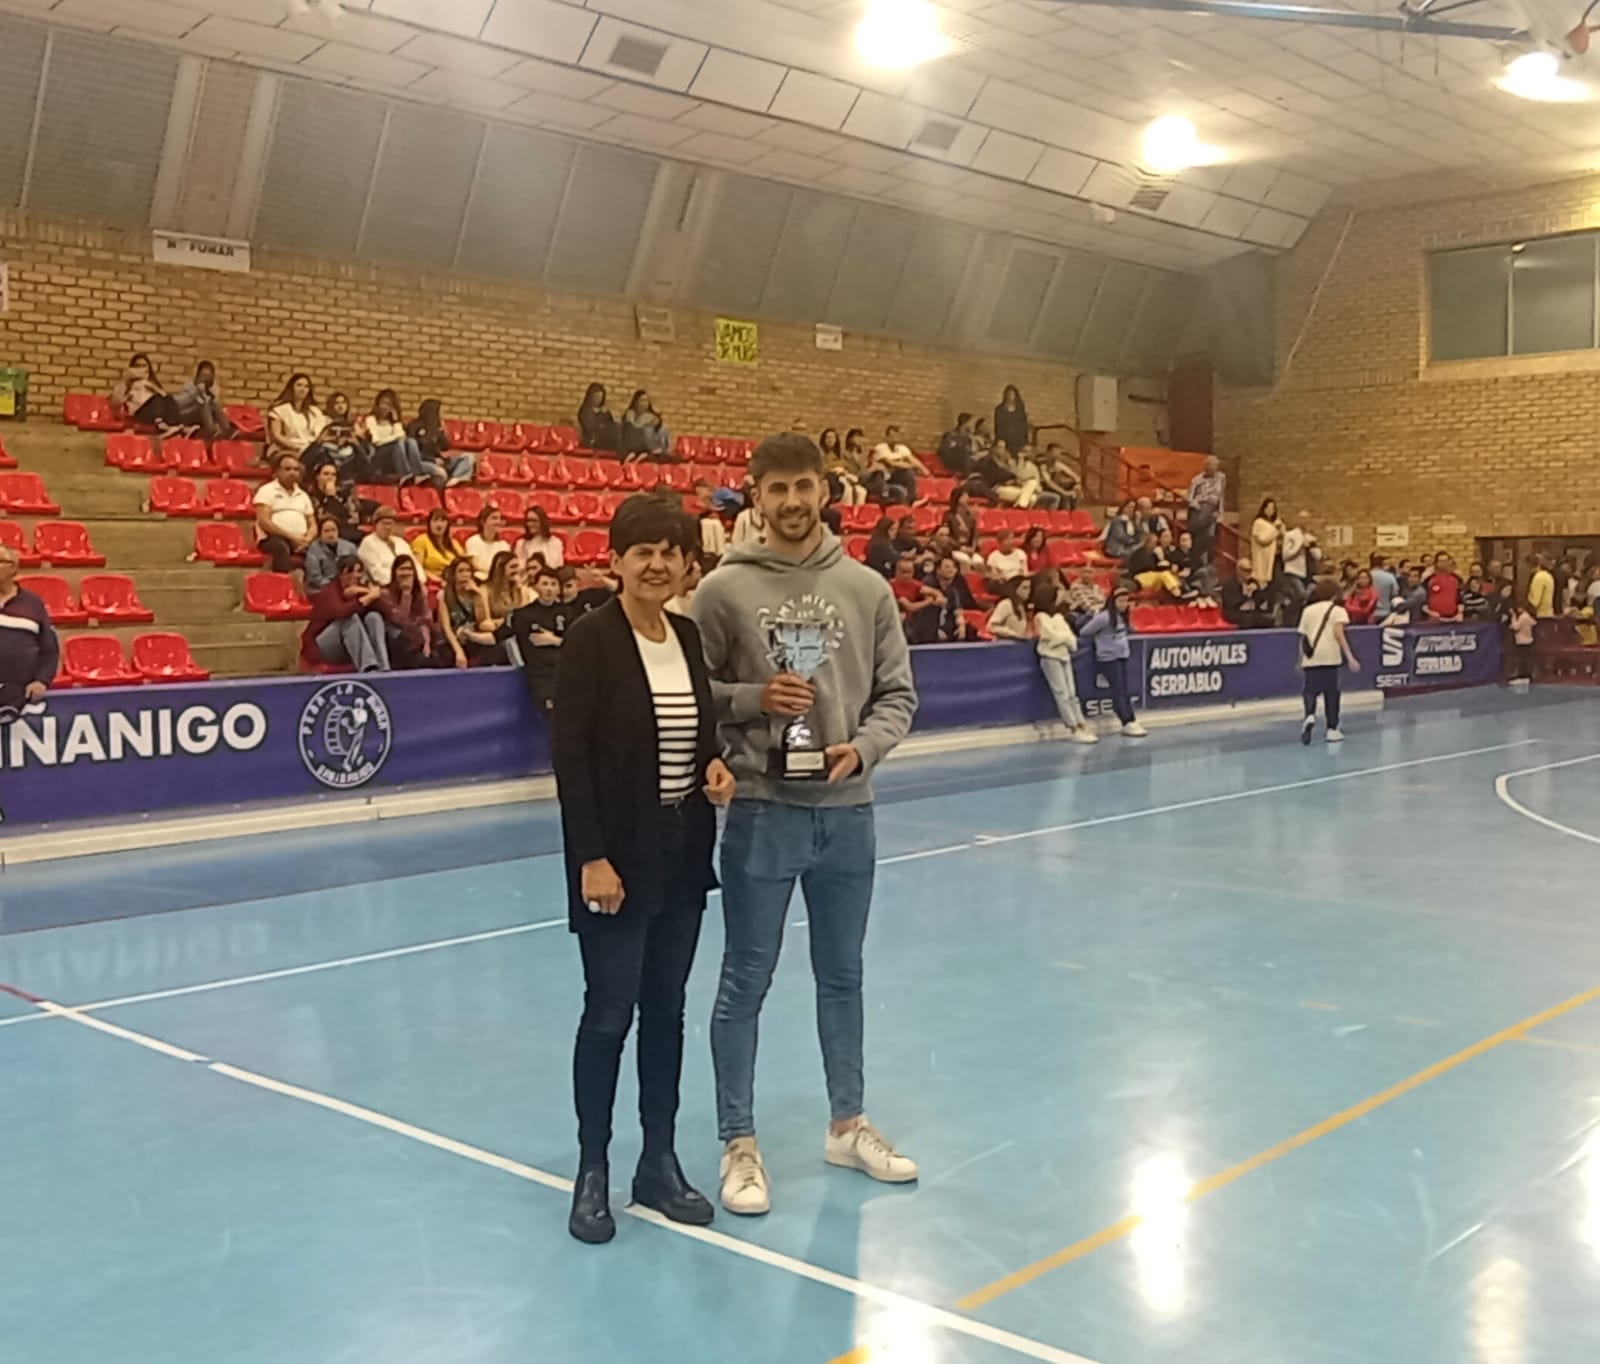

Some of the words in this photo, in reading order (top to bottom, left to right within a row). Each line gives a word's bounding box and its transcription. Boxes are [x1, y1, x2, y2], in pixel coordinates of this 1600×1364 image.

[1150, 640, 1248, 669] AUTOMÓVILES
[1150, 670, 1223, 697] SERRABLO
[0, 702, 267, 768] ÑANIGO
